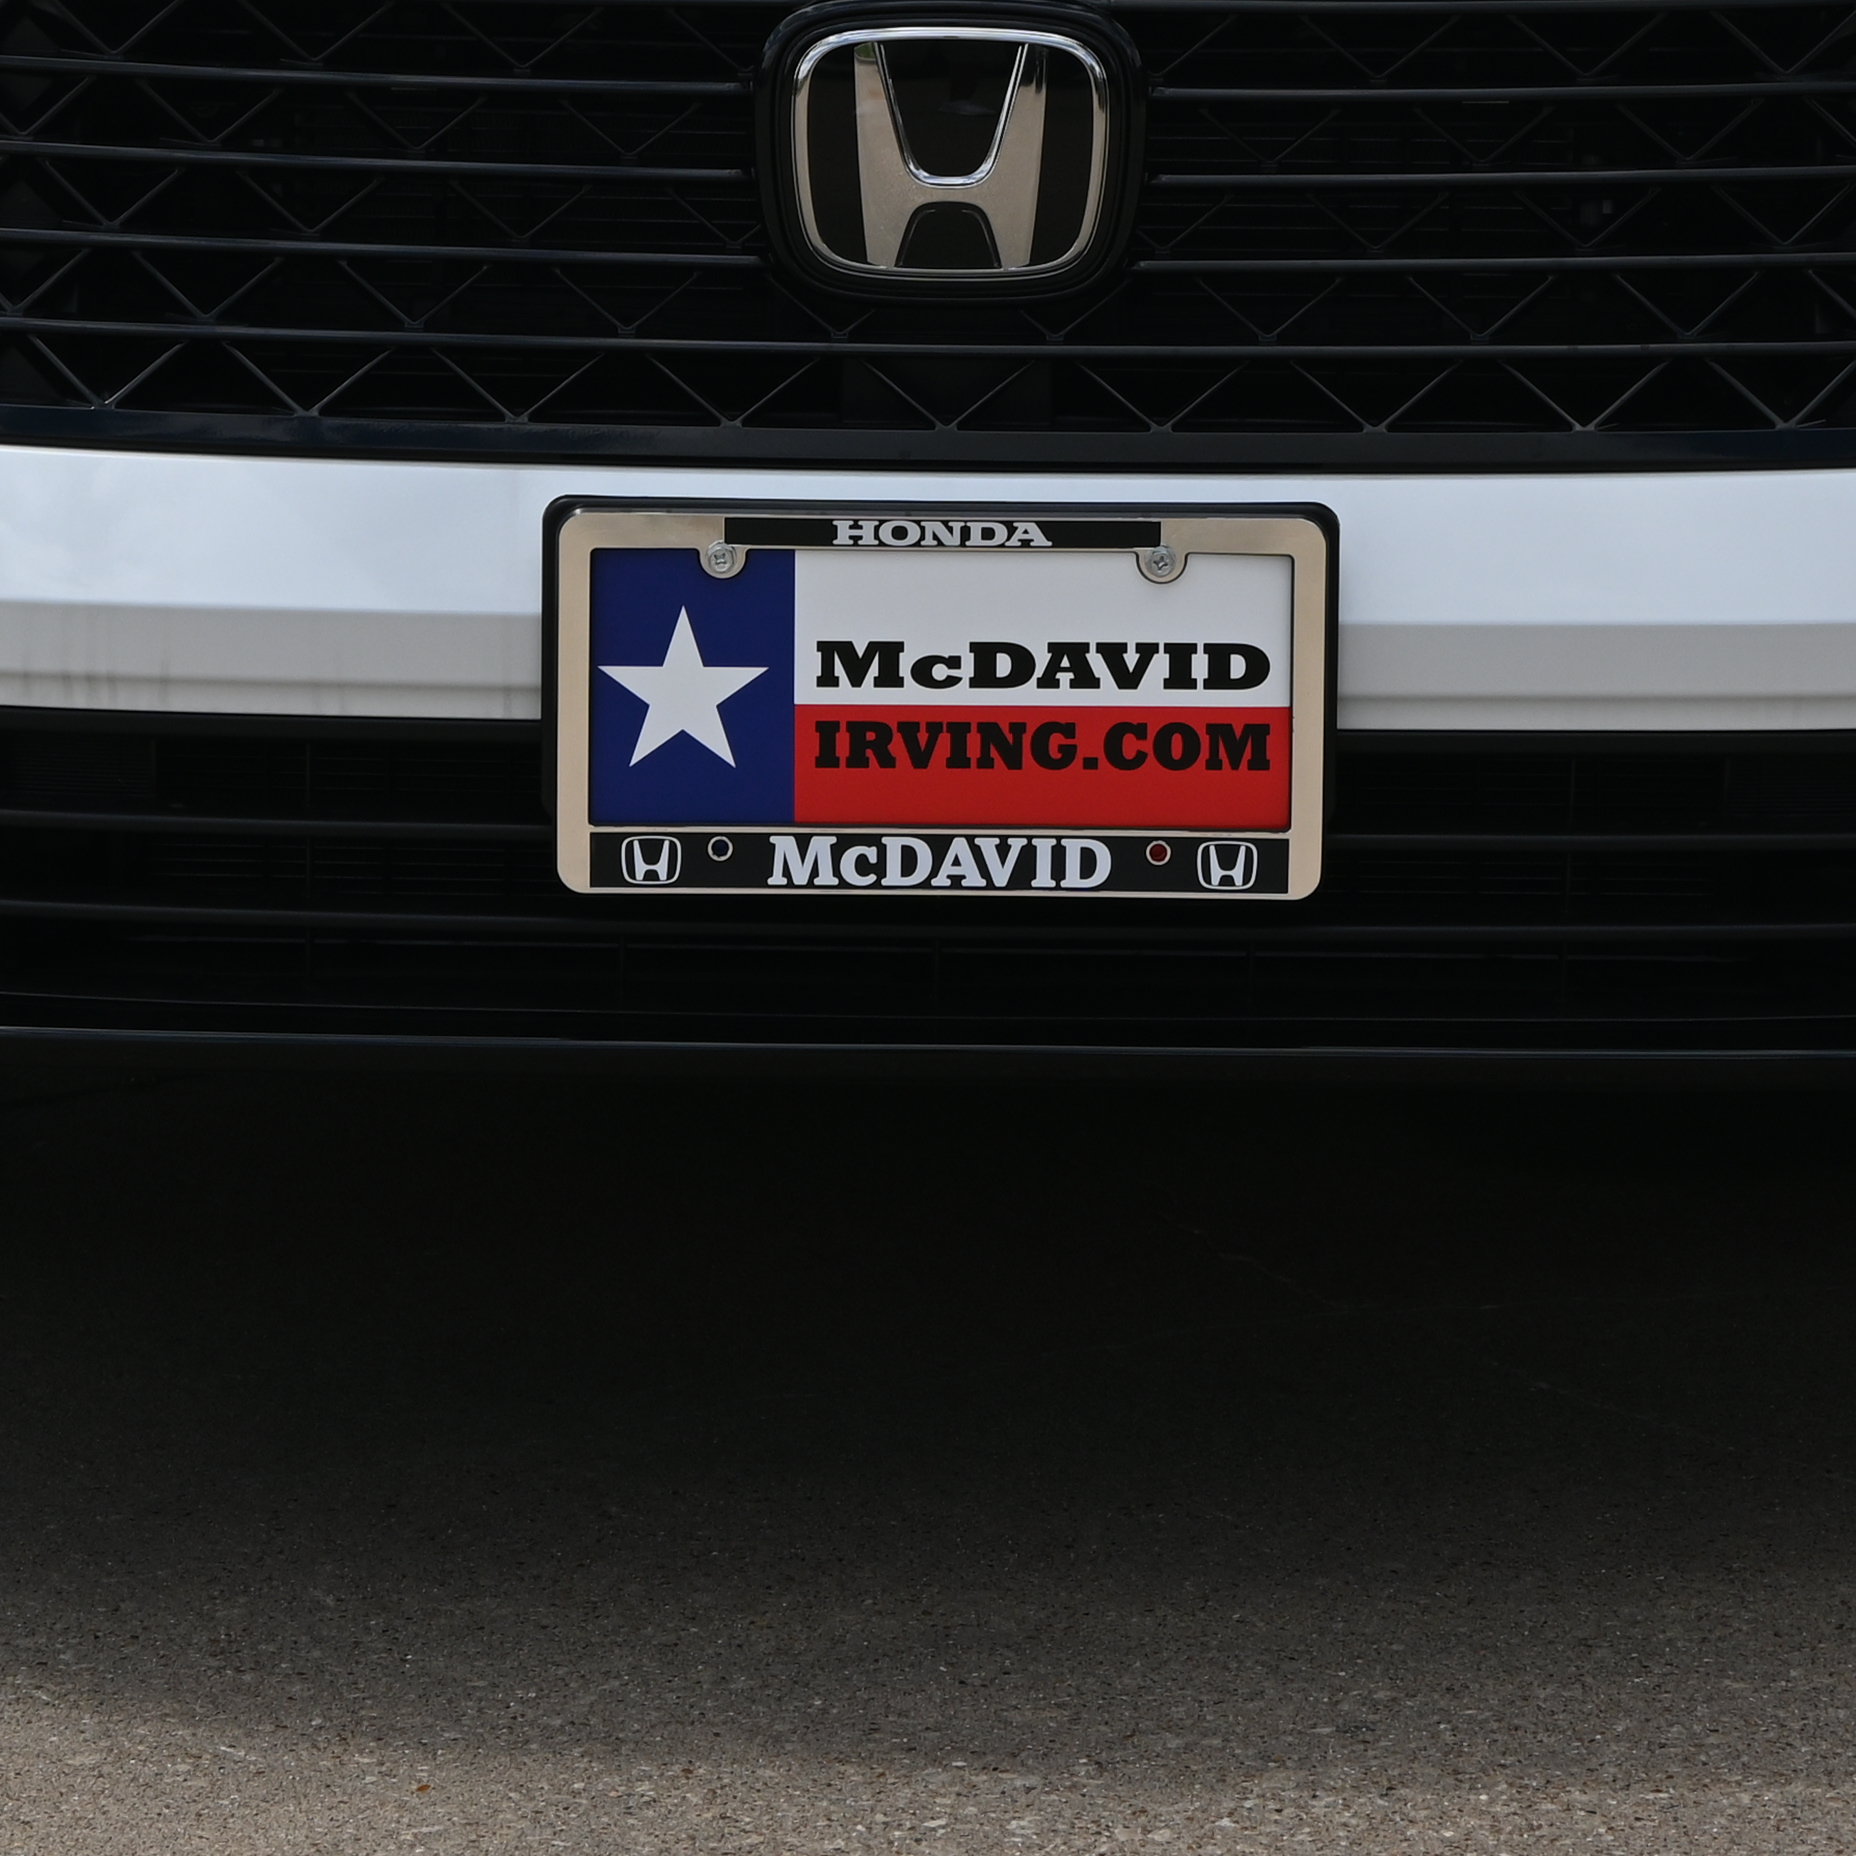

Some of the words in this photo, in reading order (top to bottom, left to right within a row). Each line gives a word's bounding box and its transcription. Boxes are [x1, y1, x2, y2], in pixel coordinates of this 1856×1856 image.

[832, 520, 1052, 546] HONDA
[816, 641, 1271, 690] McDAVID
[816, 721, 1271, 771] IRVING.COM
[766, 836, 1112, 888] McDAVID
